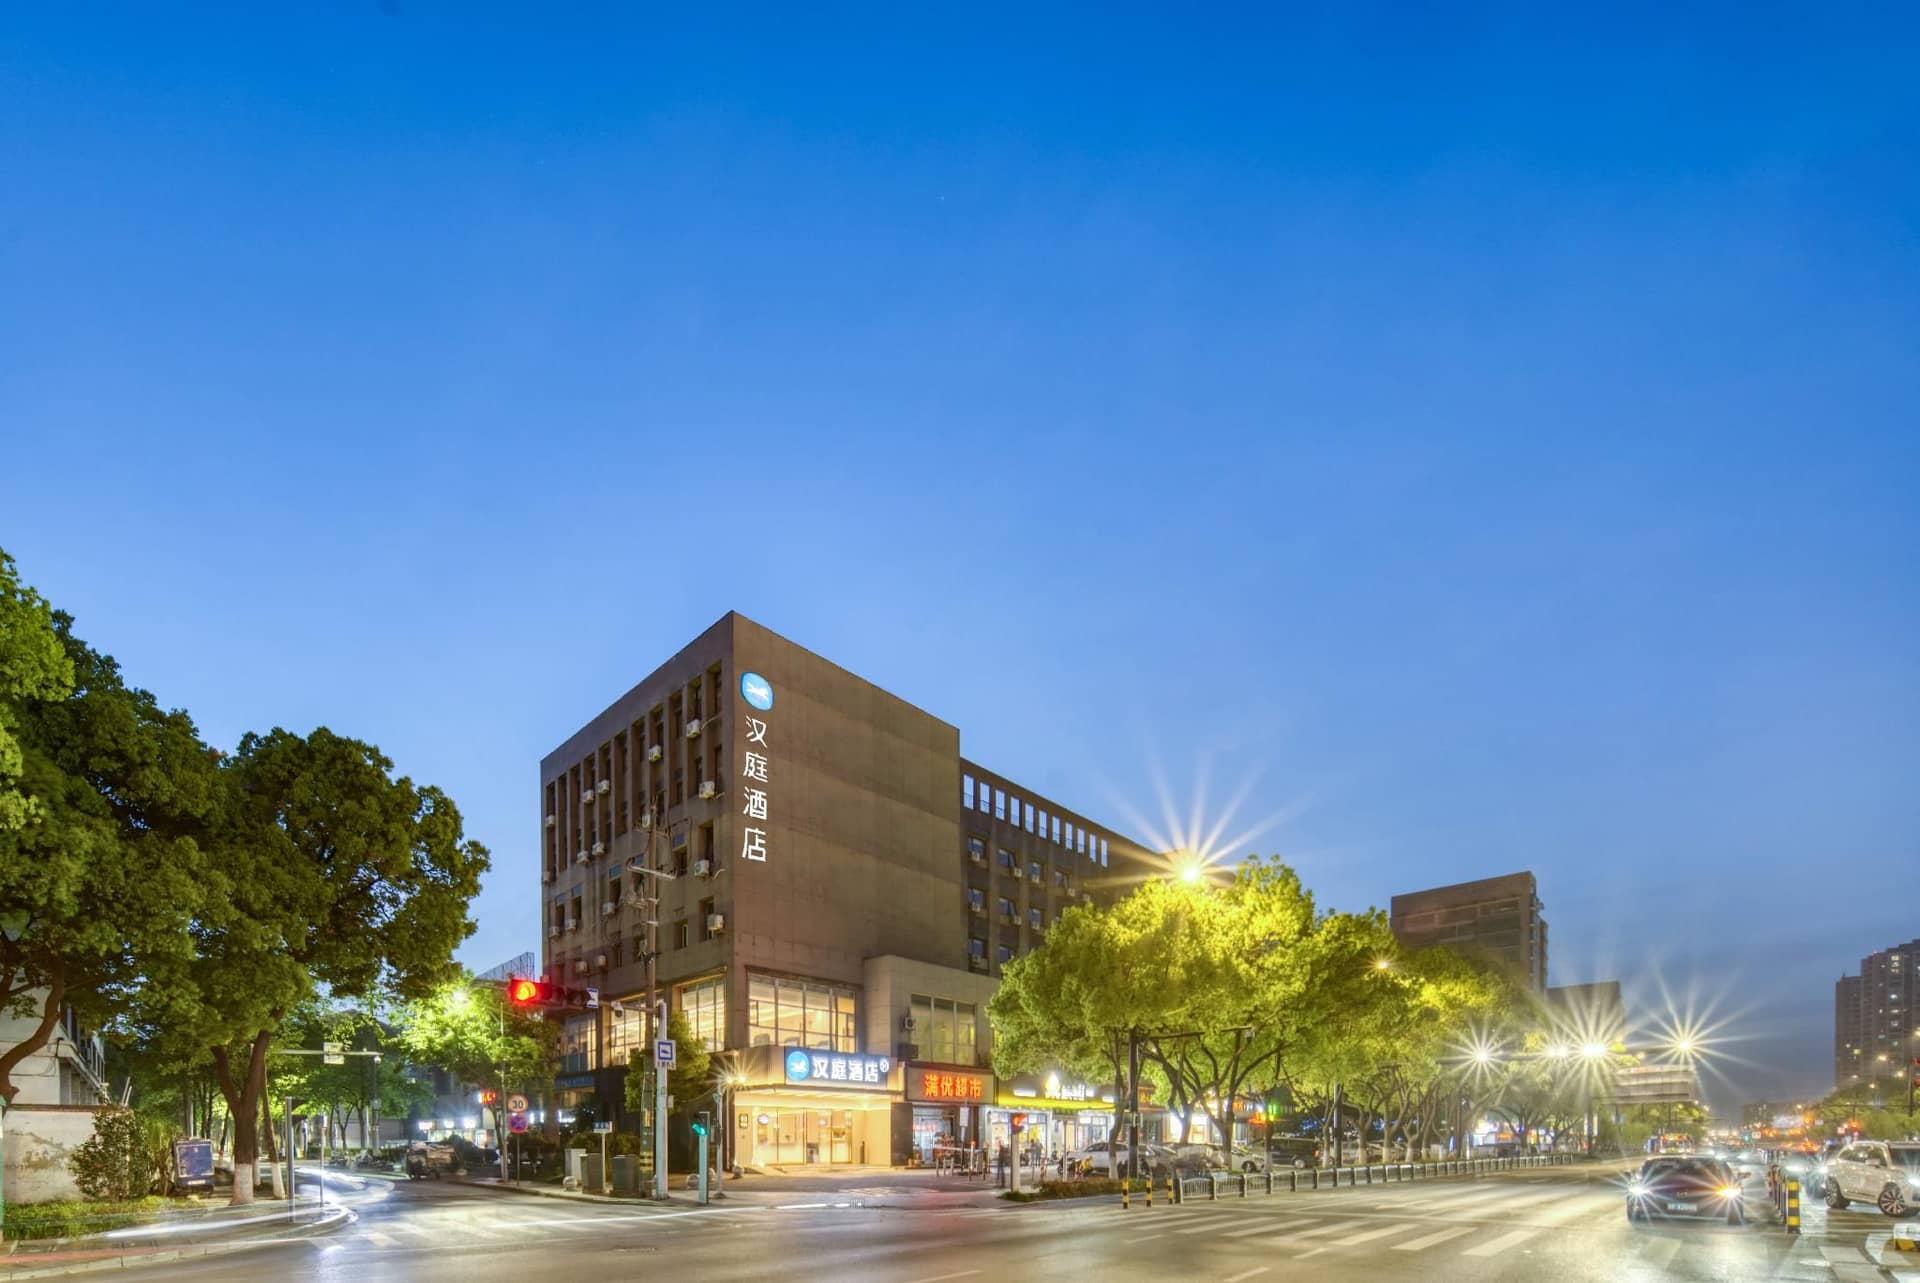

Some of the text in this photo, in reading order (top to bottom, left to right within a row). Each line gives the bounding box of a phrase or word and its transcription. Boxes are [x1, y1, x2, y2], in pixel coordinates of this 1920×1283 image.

[742, 715, 768, 862] 汉庭酒店
[812, 1056, 879, 1082] 汉庭酒店
[512, 1100, 524, 1109] 30
